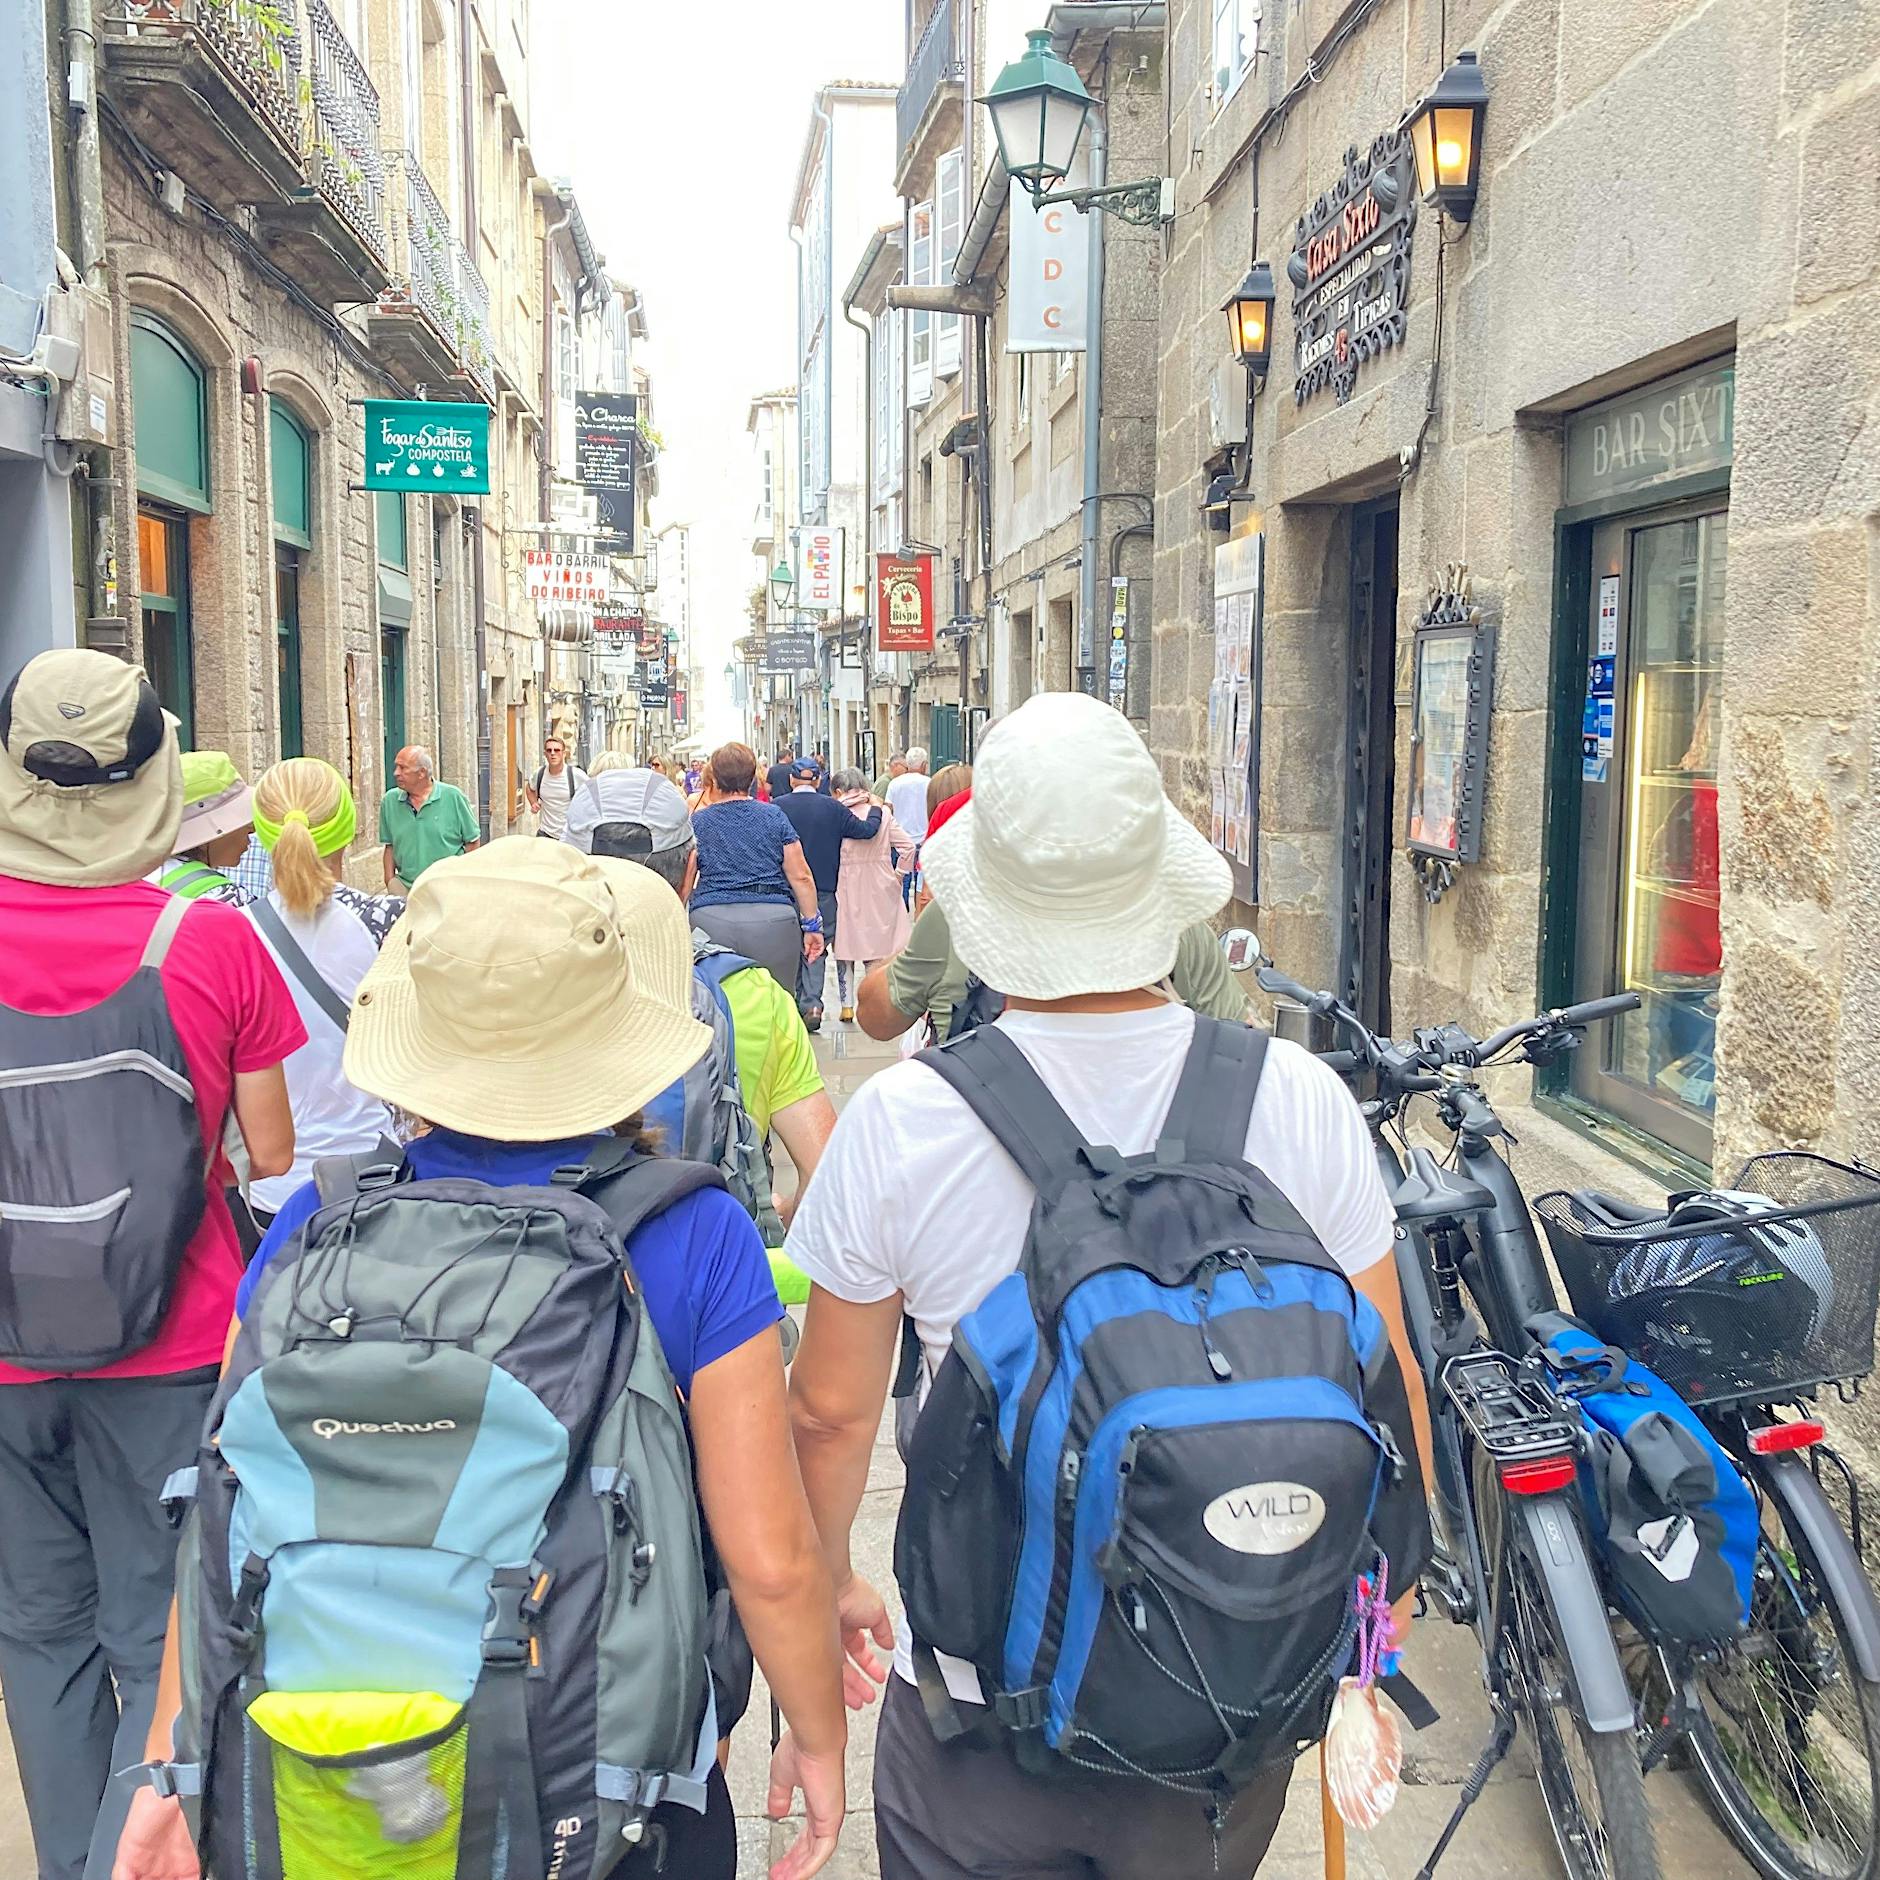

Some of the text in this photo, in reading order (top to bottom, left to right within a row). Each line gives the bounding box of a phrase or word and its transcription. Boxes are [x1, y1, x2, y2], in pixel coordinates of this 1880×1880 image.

[1307, 187, 1379, 283] Casa Sixto
[1320, 250, 1372, 306] ESPECIALIDAD
[575, 405, 636, 423] A Charca
[1593, 380, 1734, 477] BAR SIXT
[408, 448, 473, 463] COMPOSTELA
[527, 550, 609, 569] BAR O BARRIL
[531, 585, 606, 601] DO RIBEIRO
[813, 583, 830, 599] EL
[610, 607, 643, 617] CHARCA
[893, 610, 919, 622] Bispo
[888, 627, 907, 635] Tapas
[312, 1418, 457, 1440] Quechua
[1226, 1494, 1311, 1519] WILD
[554, 1816, 581, 1838] 40
